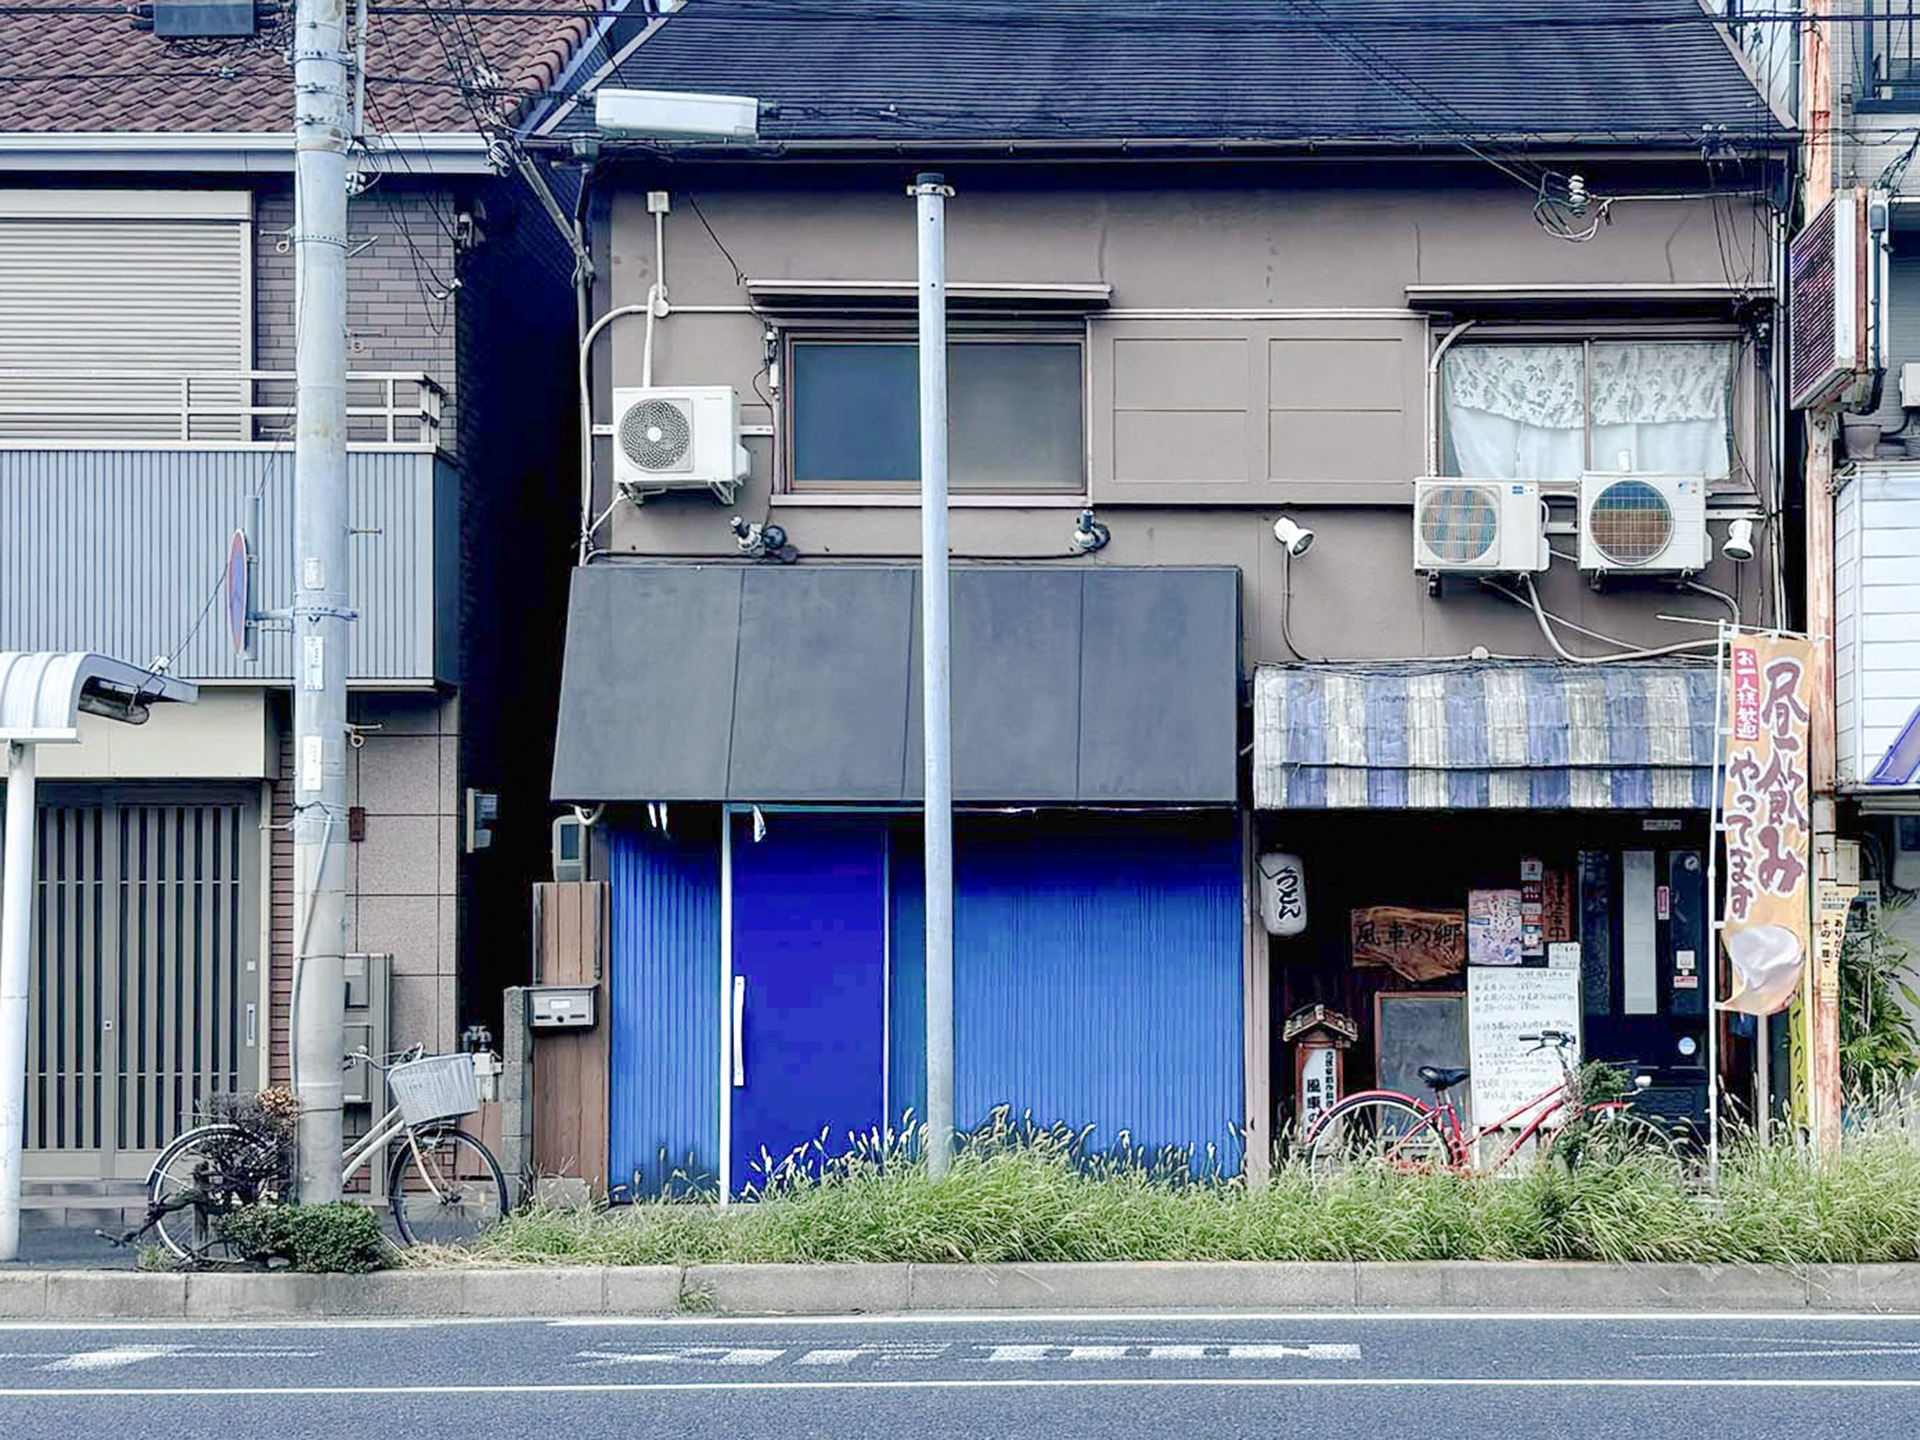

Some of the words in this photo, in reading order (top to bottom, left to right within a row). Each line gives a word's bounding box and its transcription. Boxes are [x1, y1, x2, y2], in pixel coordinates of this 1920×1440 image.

[1736, 650, 1758, 740] お一人様歓迎
[1755, 661, 1809, 892] 昼飲み
[1726, 751, 1761, 919] やってます
[1276, 865, 1301, 920] うどん
[1356, 920, 1464, 952] 風車の郷
[1306, 1078, 1322, 1133] 風車の
